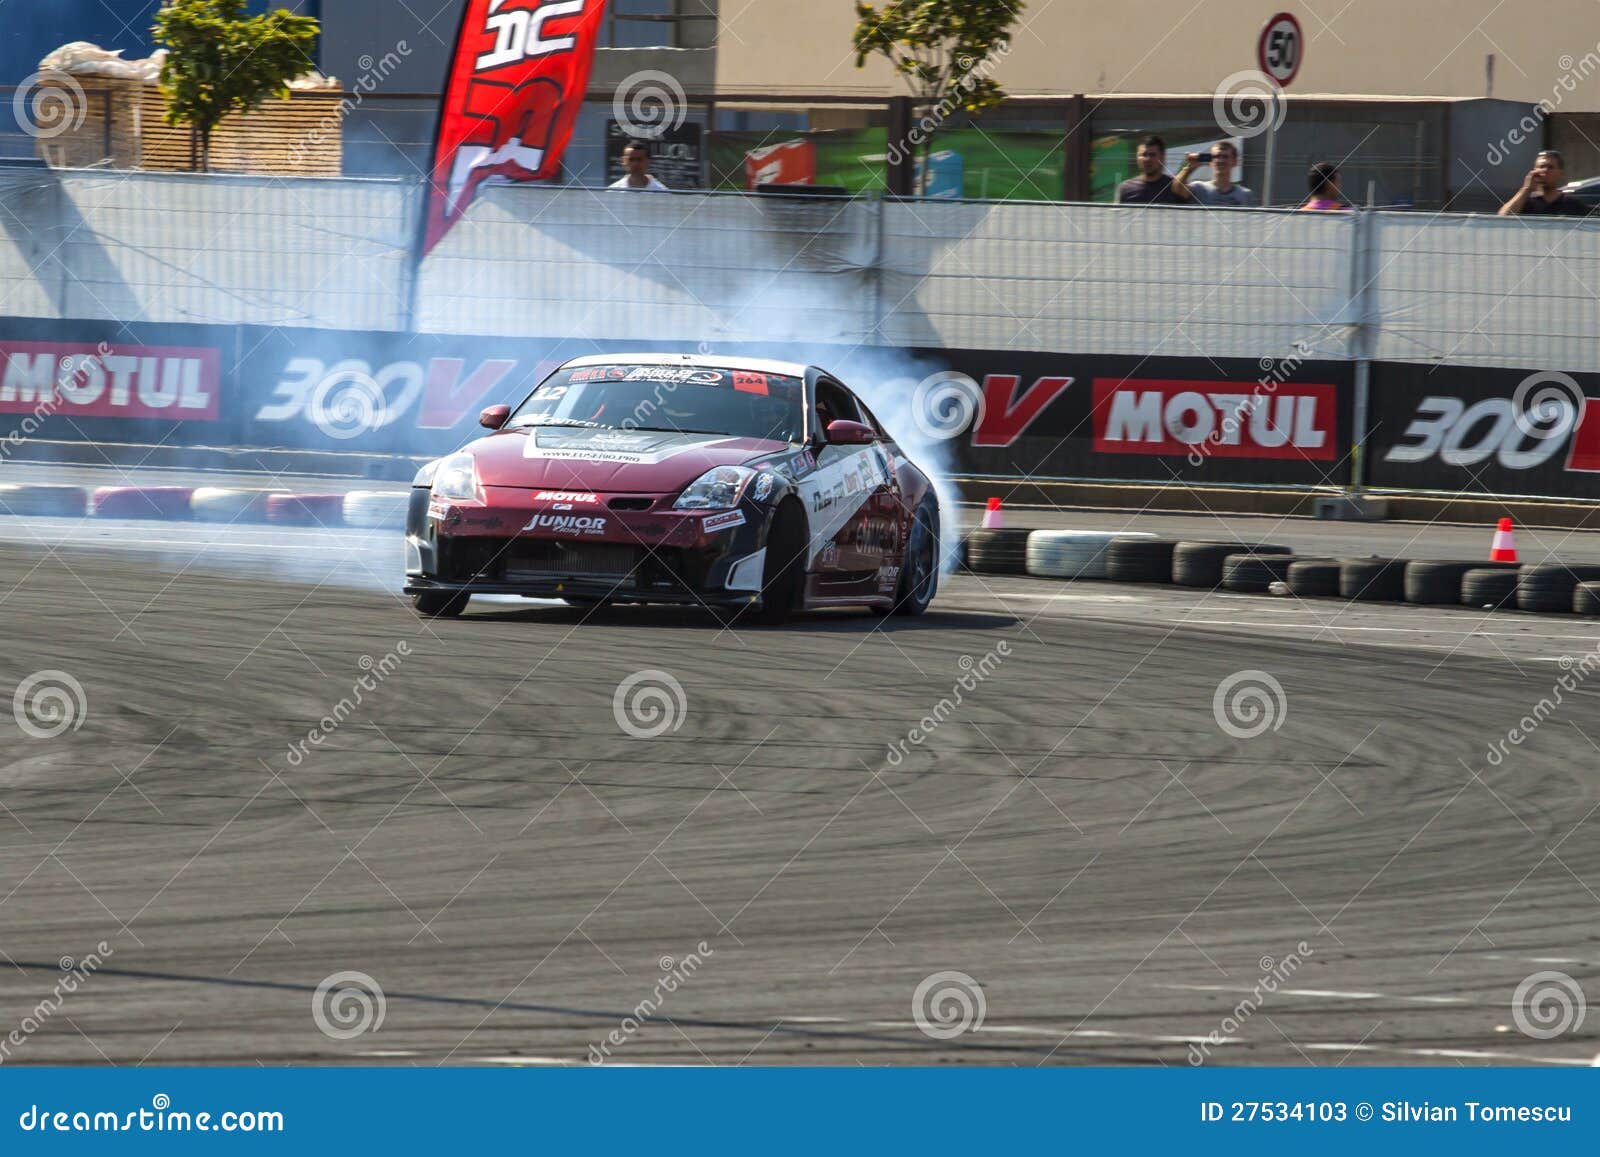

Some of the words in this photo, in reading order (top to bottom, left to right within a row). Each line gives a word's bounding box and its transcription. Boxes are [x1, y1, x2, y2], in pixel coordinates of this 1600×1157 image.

[1267, 31, 1295, 69] 50
[1, 352, 211, 409] MOTUL
[255, 357, 520, 431] 300V
[736, 376, 764, 386] 264
[1103, 390, 1328, 450] MOTUL
[534, 491, 597, 503] MOTUL
[522, 514, 607, 531] JUNIOR
